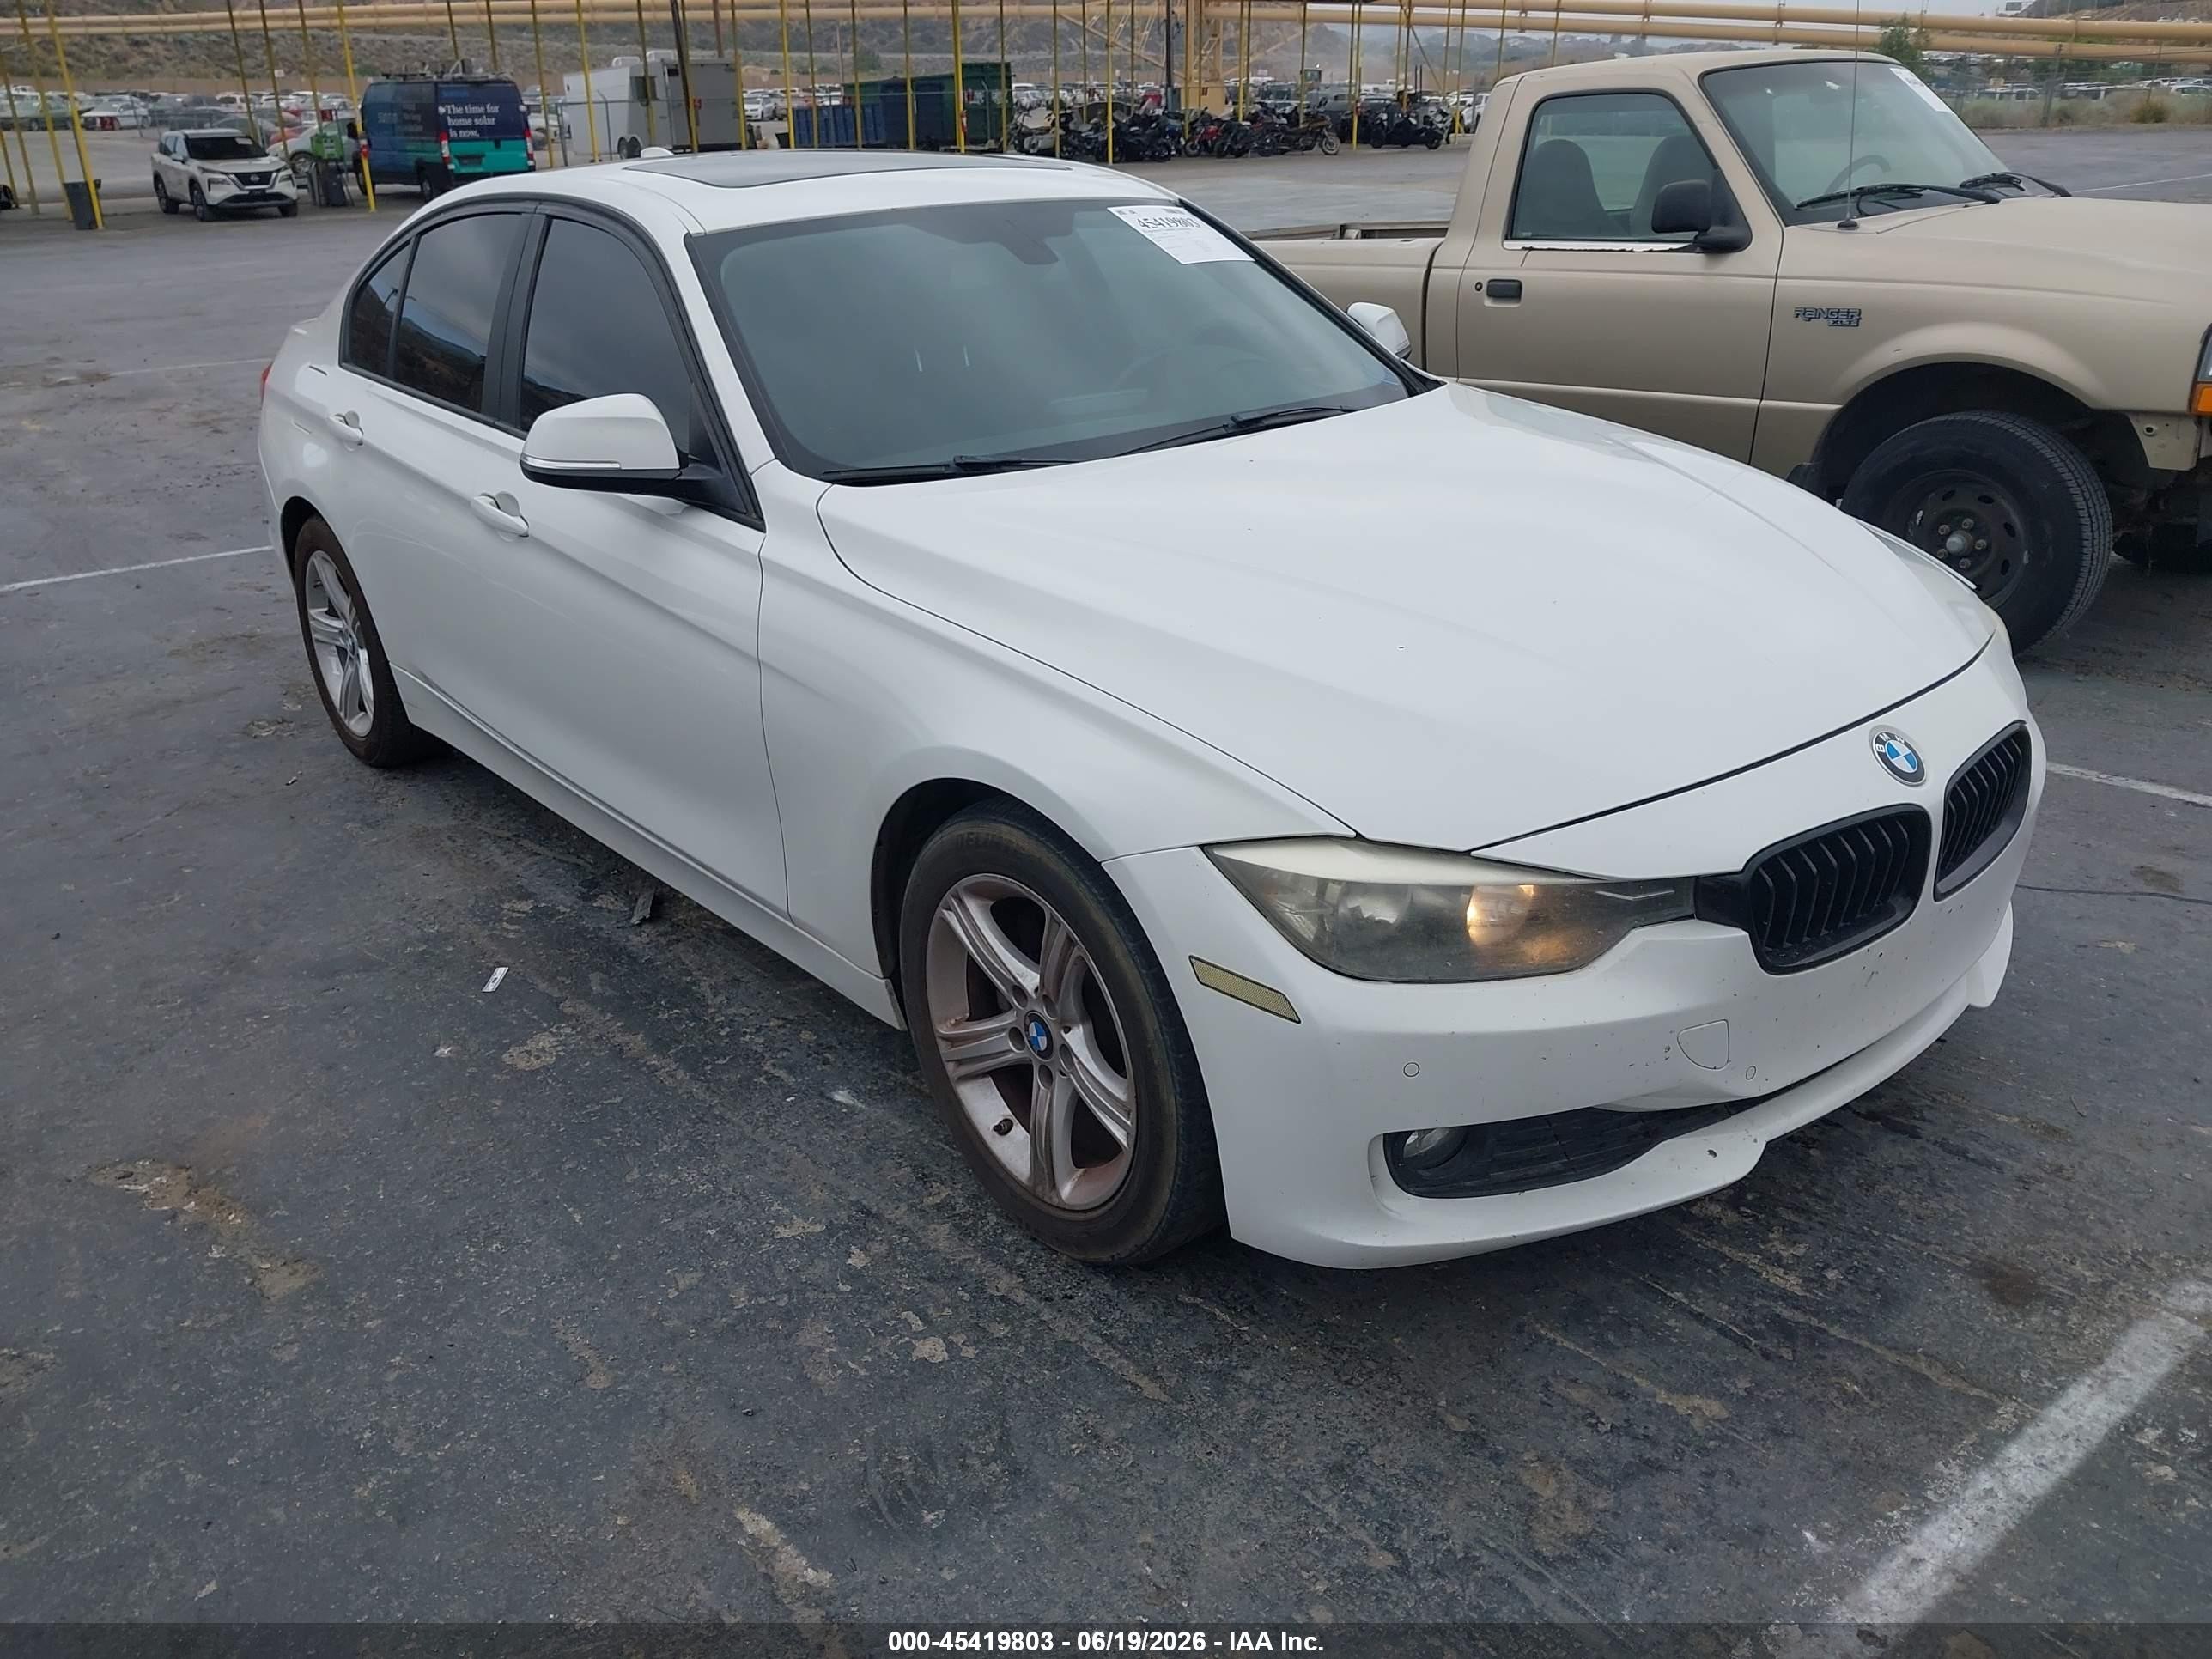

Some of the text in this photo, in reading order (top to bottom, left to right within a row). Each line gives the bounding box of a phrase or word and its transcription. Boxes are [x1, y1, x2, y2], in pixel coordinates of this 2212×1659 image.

[446, 103, 500, 114] The time for
[447, 114, 496, 126] home solar
[448, 129, 480, 137] is now.
[1137, 216, 1202, 229] 45419803
[1794, 307, 1863, 321] RANGER
